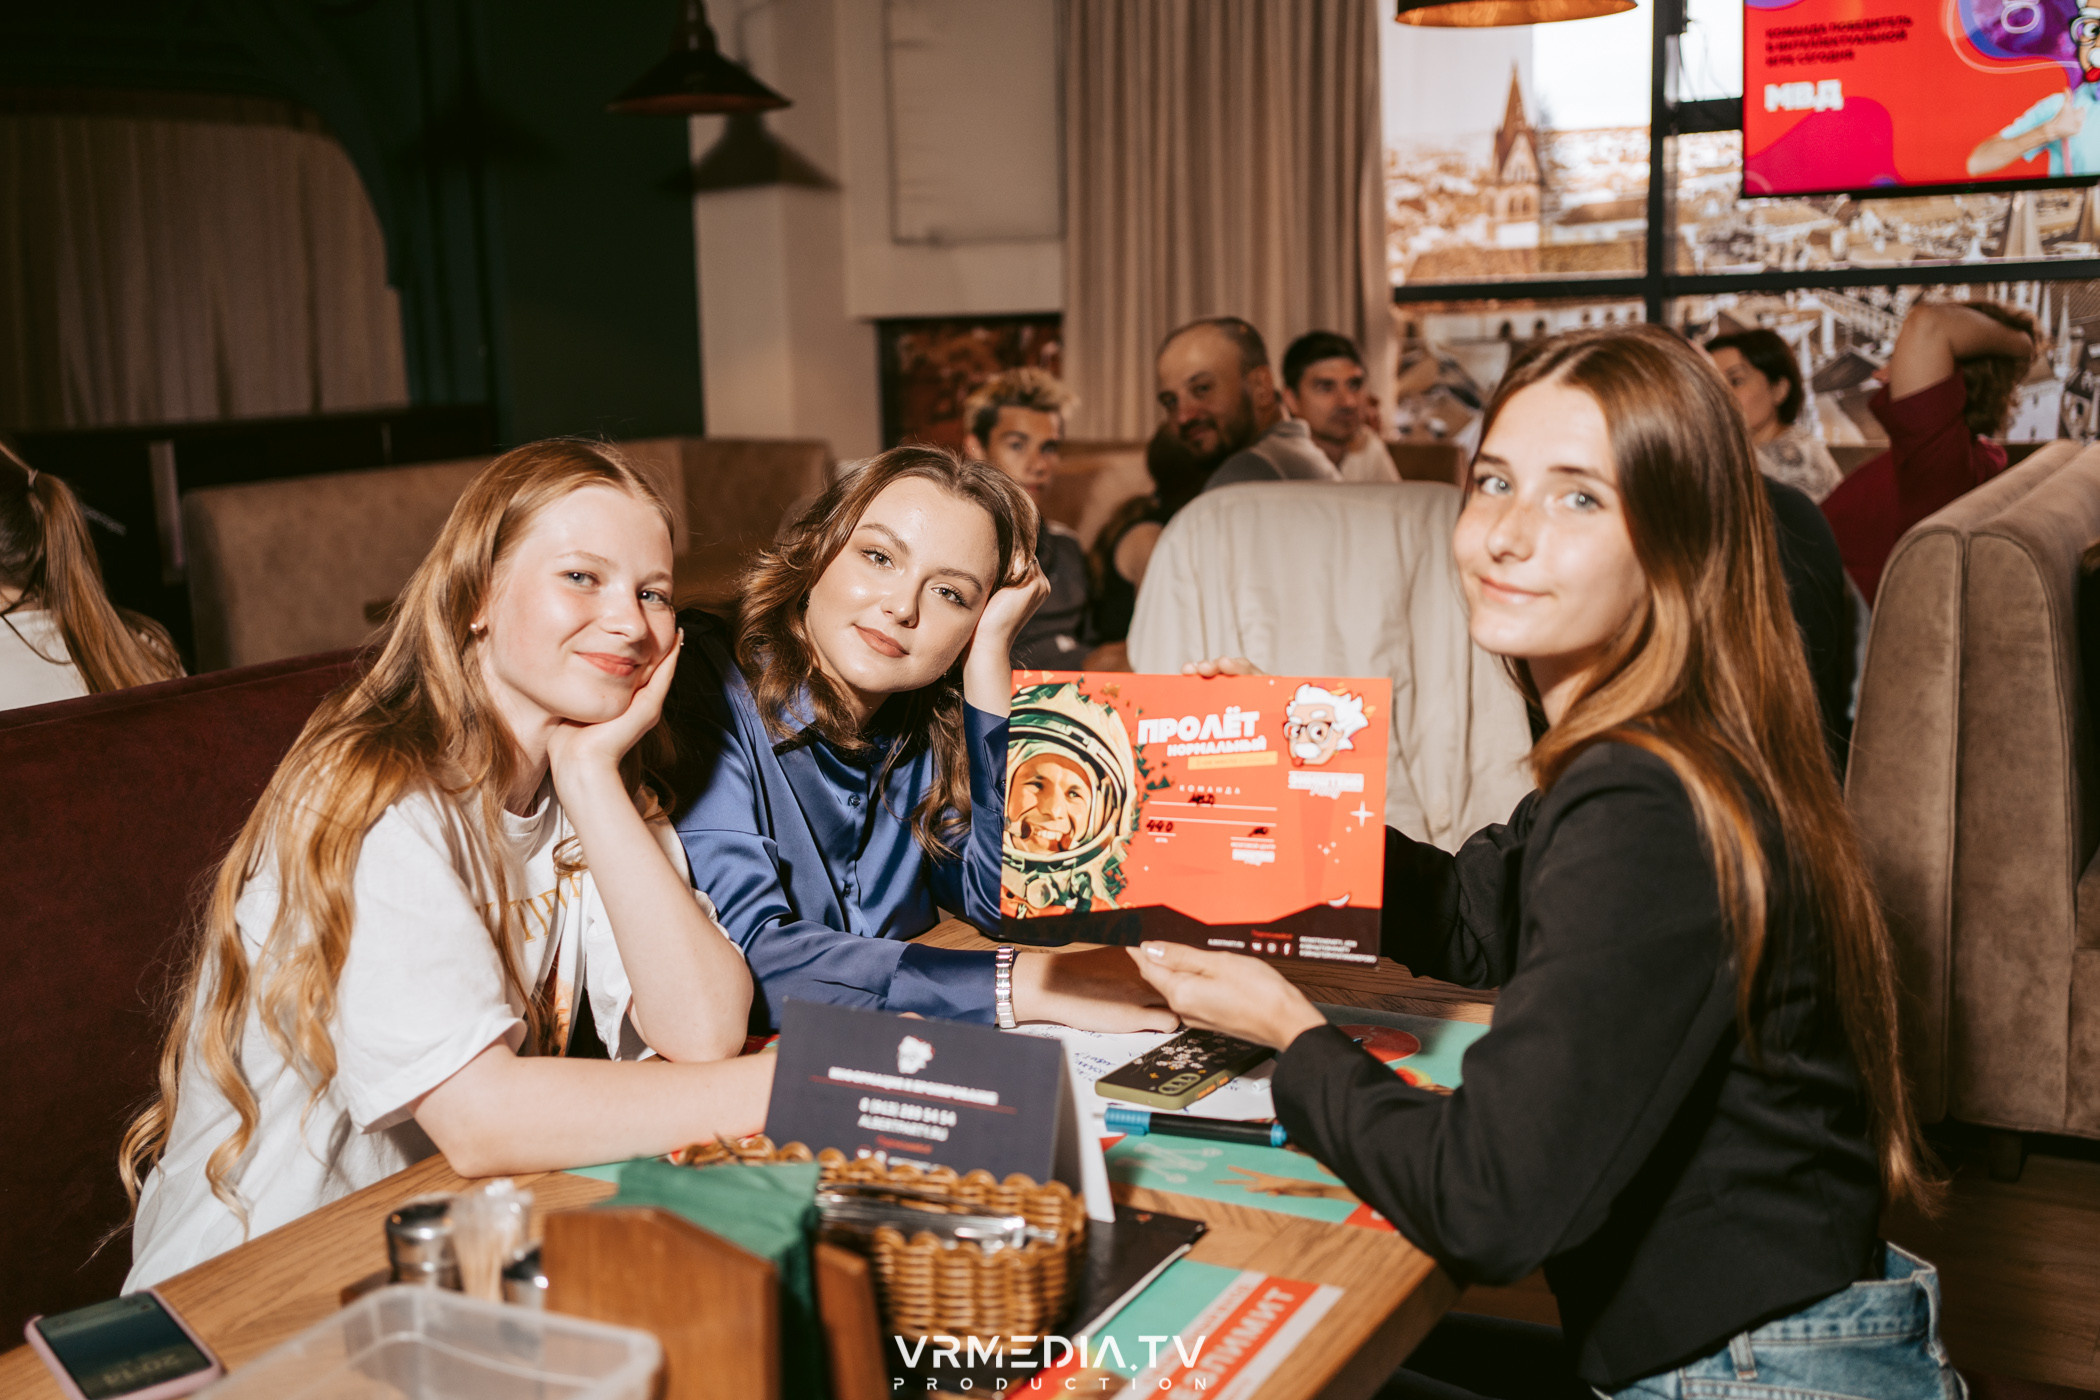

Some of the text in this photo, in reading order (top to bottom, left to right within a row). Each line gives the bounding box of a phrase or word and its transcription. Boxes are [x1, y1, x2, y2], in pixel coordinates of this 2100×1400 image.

[1764, 79, 1844, 112] МВД
[1138, 706, 1260, 745] ПРОЛЁТ
[1167, 735, 1267, 757] НОРМАЛЬНЫЙ
[1179, 785, 1241, 795] КОМАНДА
[1164, 1286, 1295, 1400] ЕЗЛИМИТ
